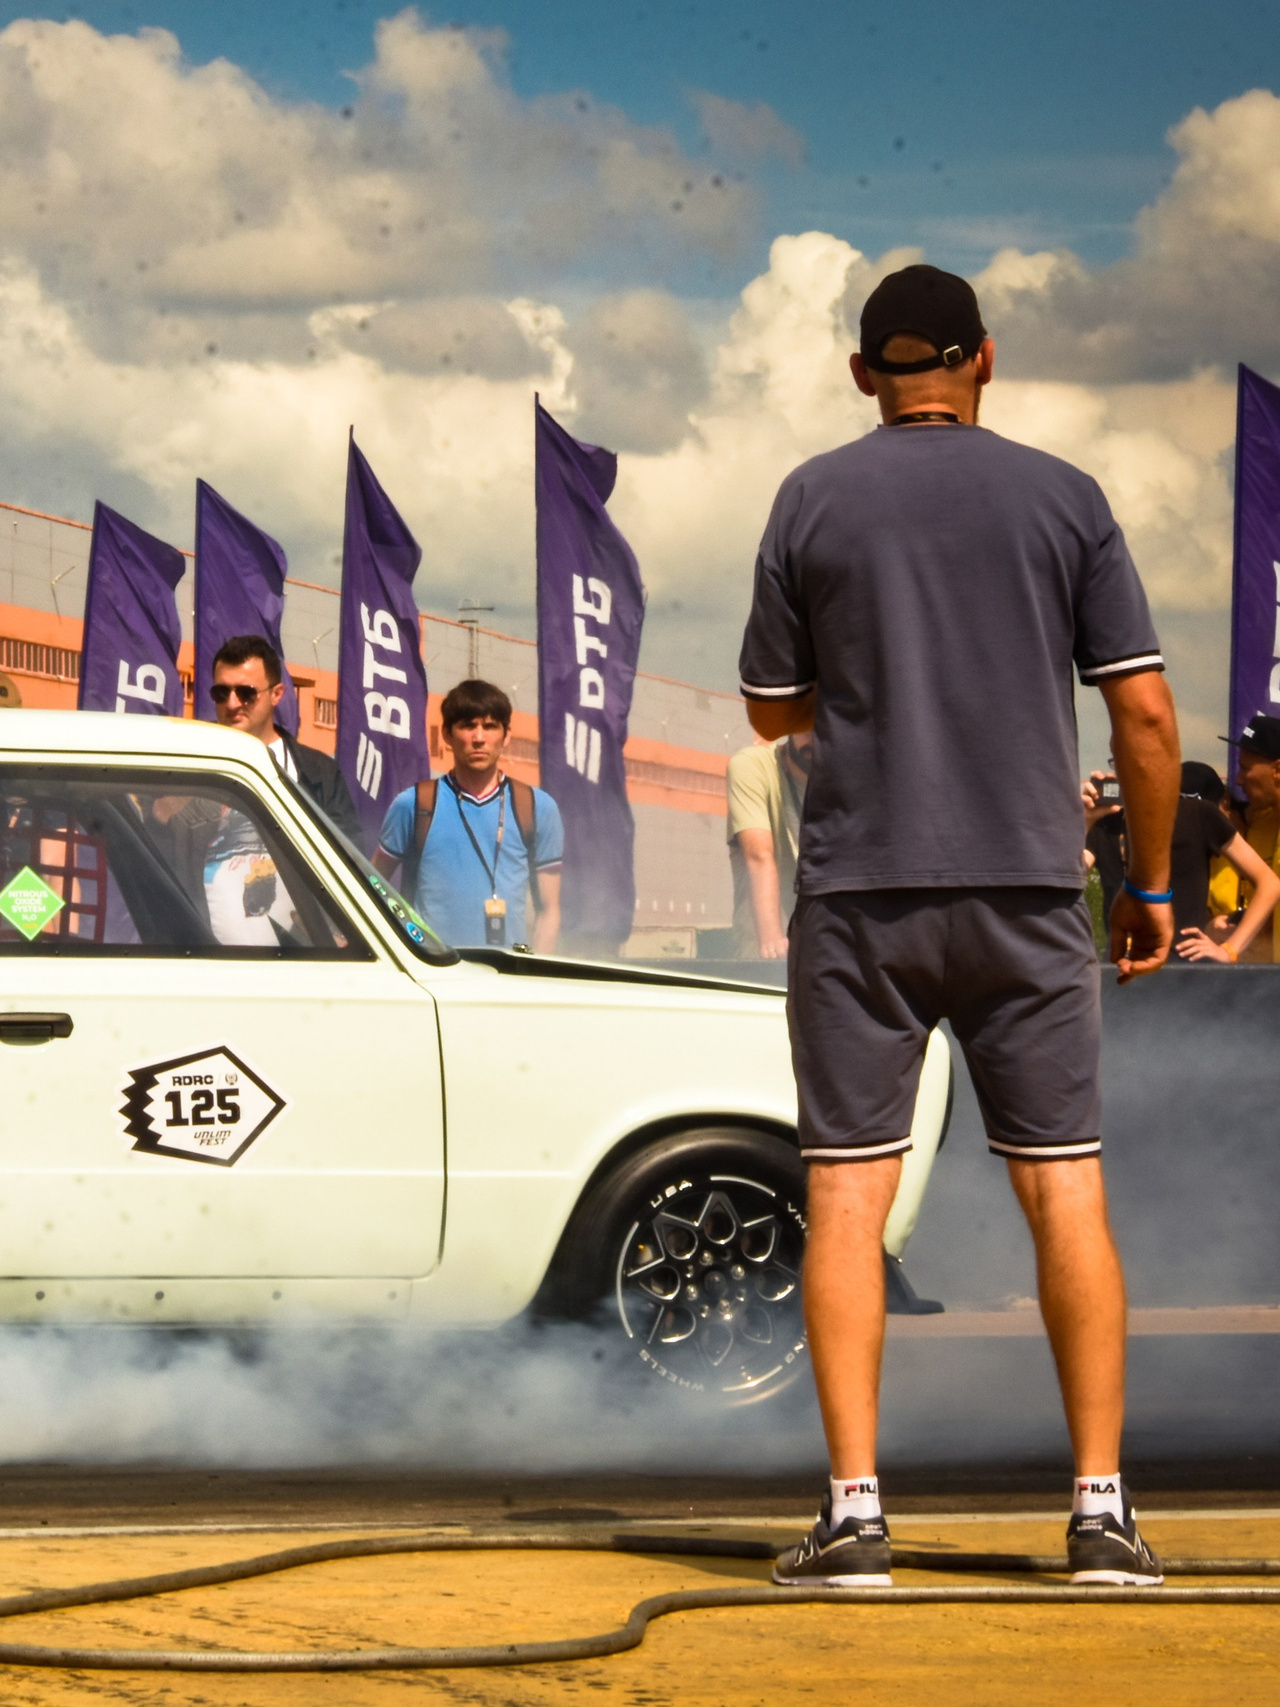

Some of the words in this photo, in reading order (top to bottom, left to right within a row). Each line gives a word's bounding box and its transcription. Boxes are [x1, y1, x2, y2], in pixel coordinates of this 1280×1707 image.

[361, 602, 411, 740] ВТБ
[8, 889, 48, 898] NITROUS
[14, 897, 42, 906] OXIDE
[11, 905, 47, 913] SYSTEM
[172, 1074, 214, 1086] RDRC
[164, 1088, 241, 1127] 125
[199, 1138, 226, 1146] FEST
[650, 1179, 693, 1208] USA
[639, 1348, 705, 1393] WHEELS
[844, 1483, 878, 1497] FIL
[1078, 1482, 1116, 1496] FILA
